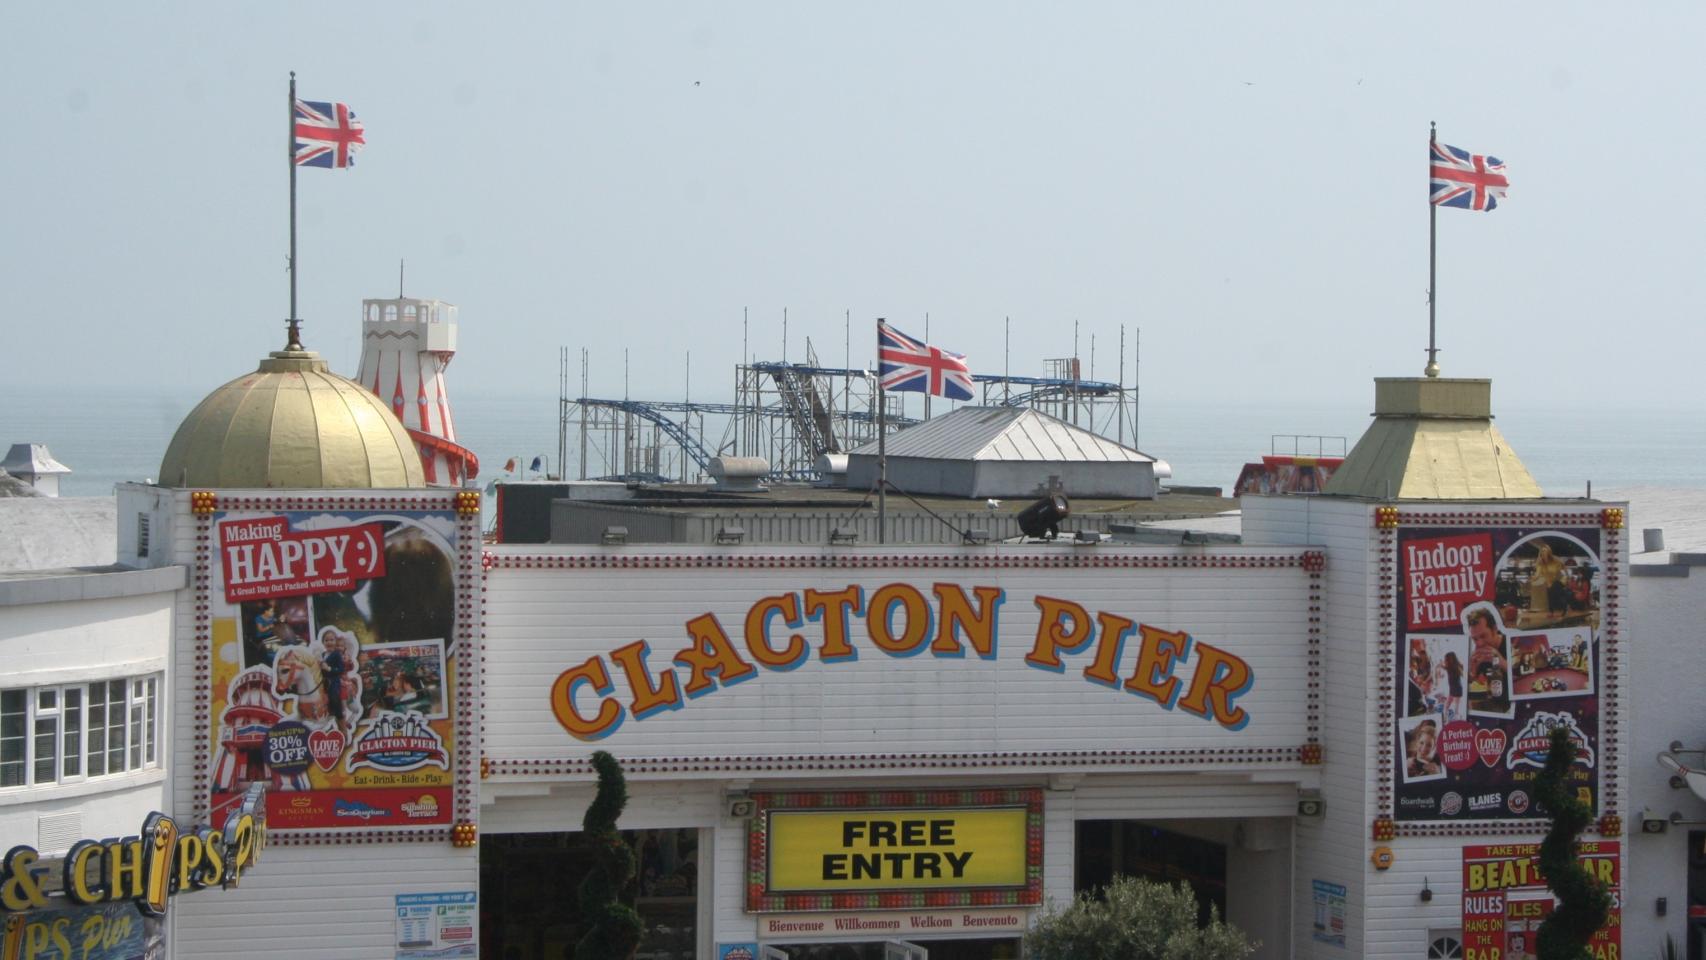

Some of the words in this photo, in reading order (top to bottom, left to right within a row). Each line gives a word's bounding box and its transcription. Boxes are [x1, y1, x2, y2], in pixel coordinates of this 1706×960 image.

[225, 523, 282, 542] Making
[227, 535, 350, 584] HAPPY
[1408, 542, 1482, 571] Indoor
[237, 587, 256, 596] Great
[257, 586, 270, 594] Day
[271, 584, 283, 592] Out
[284, 582, 309, 591] Packed
[310, 579, 325, 588] with
[326, 576, 350, 587] Happy!
[1410, 566, 1487, 597] Family
[1411, 598, 1457, 624] Fun
[551, 581, 1006, 743] CLACTON
[1024, 594, 1255, 733] PIER
[269, 735, 302, 751] 30%
[1448, 729, 1473, 740] Perfect
[313, 739, 340, 751] LOVE
[359, 739, 408, 751] CLACTON
[410, 739, 437, 749] PIER
[1443, 741, 1471, 752] Birthday
[1479, 738, 1502, 749] LOVE
[270, 747, 307, 763] OFF
[354, 776, 367, 784] Eat
[373, 775, 395, 784] Drink
[401, 775, 418, 783] Ride
[425, 774, 443, 784] Play
[1472, 793, 1501, 806] LANES
[407, 810, 438, 818] Terrace
[843, 820, 954, 847] FREE
[1487, 846, 1512, 856] TAKE
[1516, 845, 1535, 855] THE
[822, 852, 973, 880] ENTRY
[1469, 858, 1531, 890] BEAT
[1583, 858, 1613, 887] AR
[2, 848, 50, 910] &
[1465, 896, 1503, 914] RULES
[768, 920, 824, 933] Bienvenue
[834, 917, 901, 931] Willkommen
[910, 915, 953, 929] Welkom
[962, 913, 1018, 927] Benvenuto
[1465, 919, 1488, 932] HANG
[1491, 918, 1503, 931] ON
[1477, 936, 1492, 944] THE
